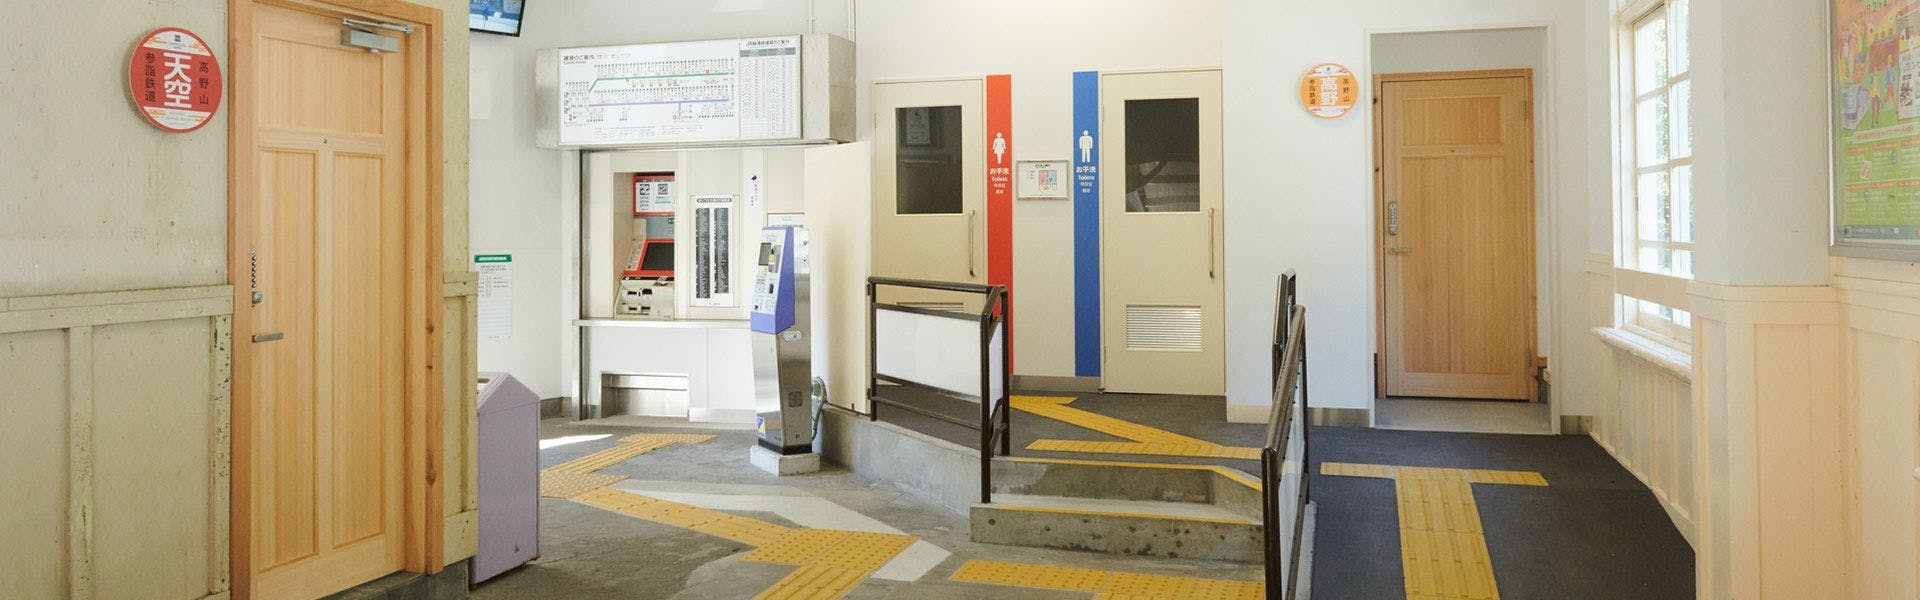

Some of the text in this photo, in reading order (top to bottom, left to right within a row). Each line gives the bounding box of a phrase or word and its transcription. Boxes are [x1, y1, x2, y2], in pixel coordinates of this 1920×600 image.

[145, 52, 156, 102] 参詣鉄道
[163, 52, 192, 108] 天空
[198, 61, 209, 105] 高野山
[1320, 77, 1338, 106] 高野
[1342, 78, 1350, 103] 高野山
